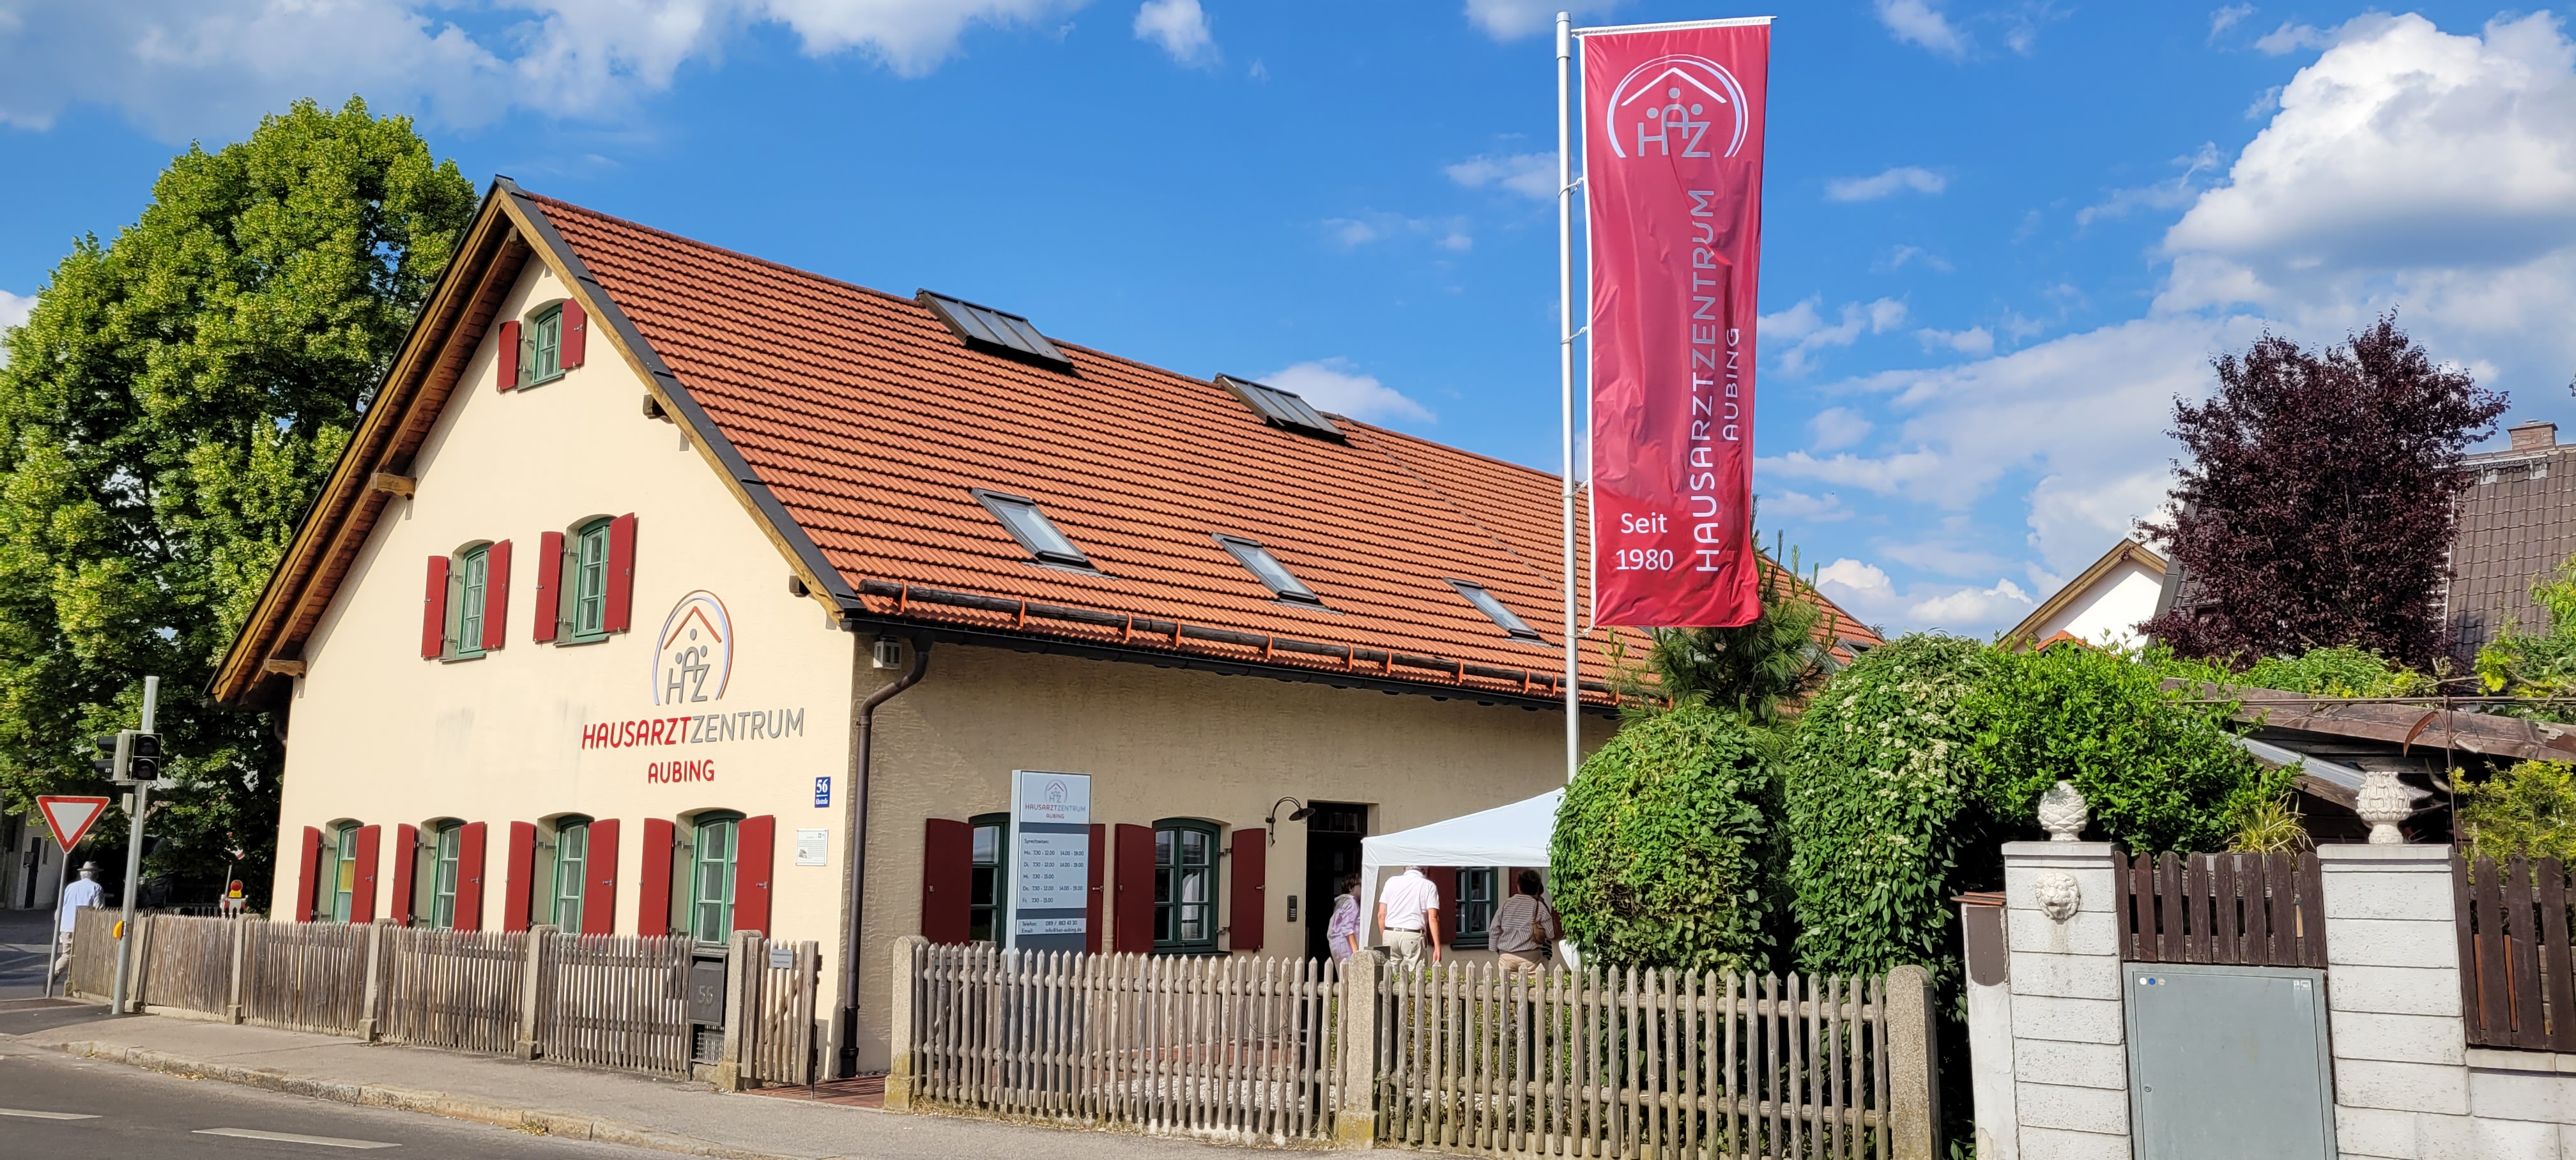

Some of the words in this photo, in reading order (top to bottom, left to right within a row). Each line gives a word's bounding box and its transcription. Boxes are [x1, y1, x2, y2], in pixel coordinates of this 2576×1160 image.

[1688, 190, 1719, 572] HAUSARZTZENTRUM
[1722, 328, 1740, 441] AUBING
[1620, 512, 1668, 534] Seit
[1616, 549, 1674, 571] 1980
[581, 707, 804, 750] HAUSARZTZENTRUM
[648, 759, 715, 784] AUBING
[816, 778, 829, 793] 56
[1025, 804, 1085, 812] HAUSARZTZENTRUM
[698, 985, 713, 1005] 56
